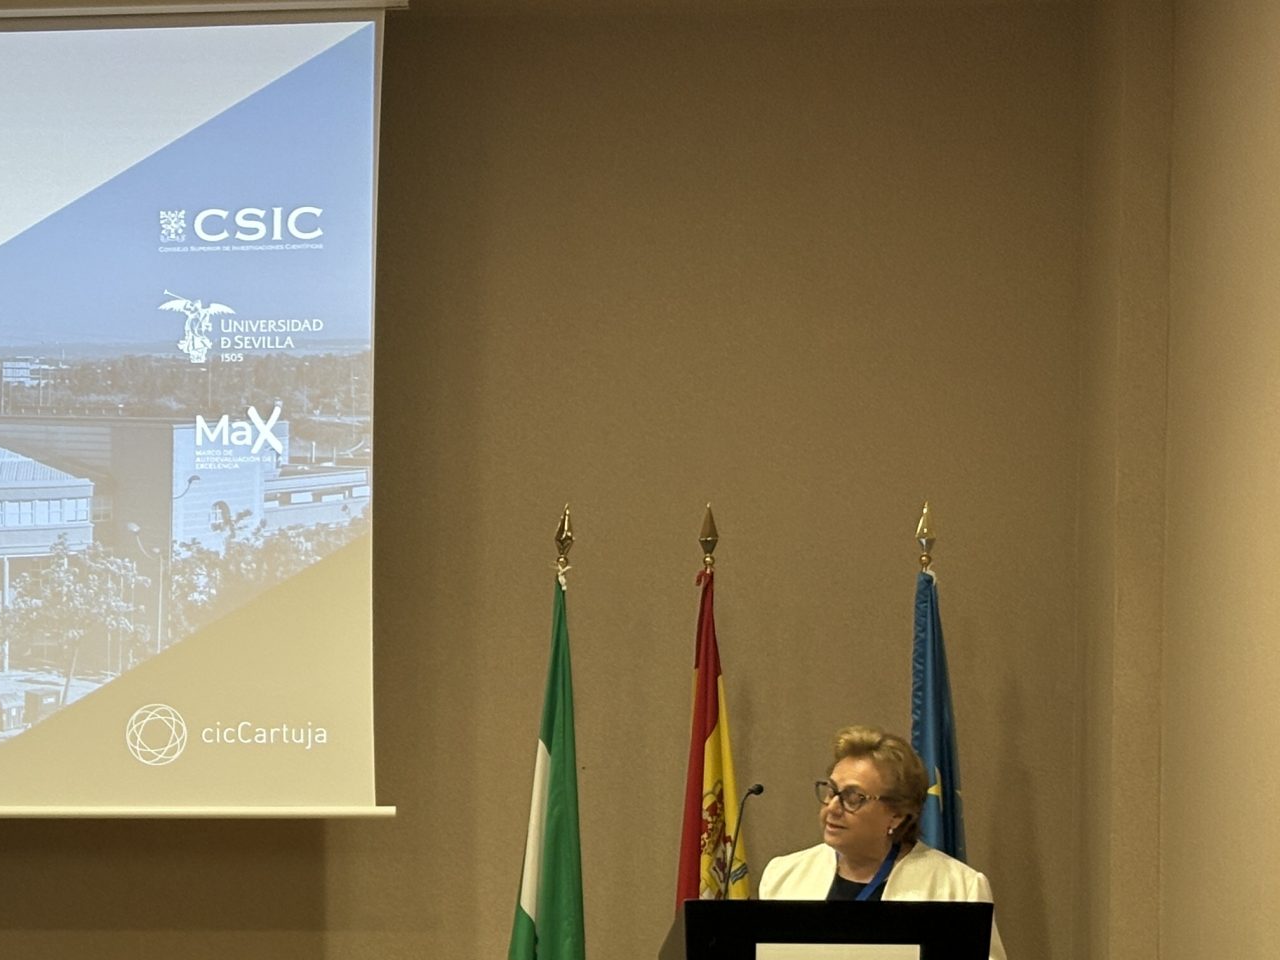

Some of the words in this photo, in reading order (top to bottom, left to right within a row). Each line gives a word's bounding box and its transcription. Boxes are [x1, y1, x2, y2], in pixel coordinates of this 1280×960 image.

[193, 206, 324, 242] CSIC
[221, 319, 324, 333] UNIVERSIDAD
[234, 335, 295, 349] SEVILLA
[221, 353, 244, 362] 1505
[195, 405, 283, 454] MaX
[202, 721, 328, 750] cicCartuja
